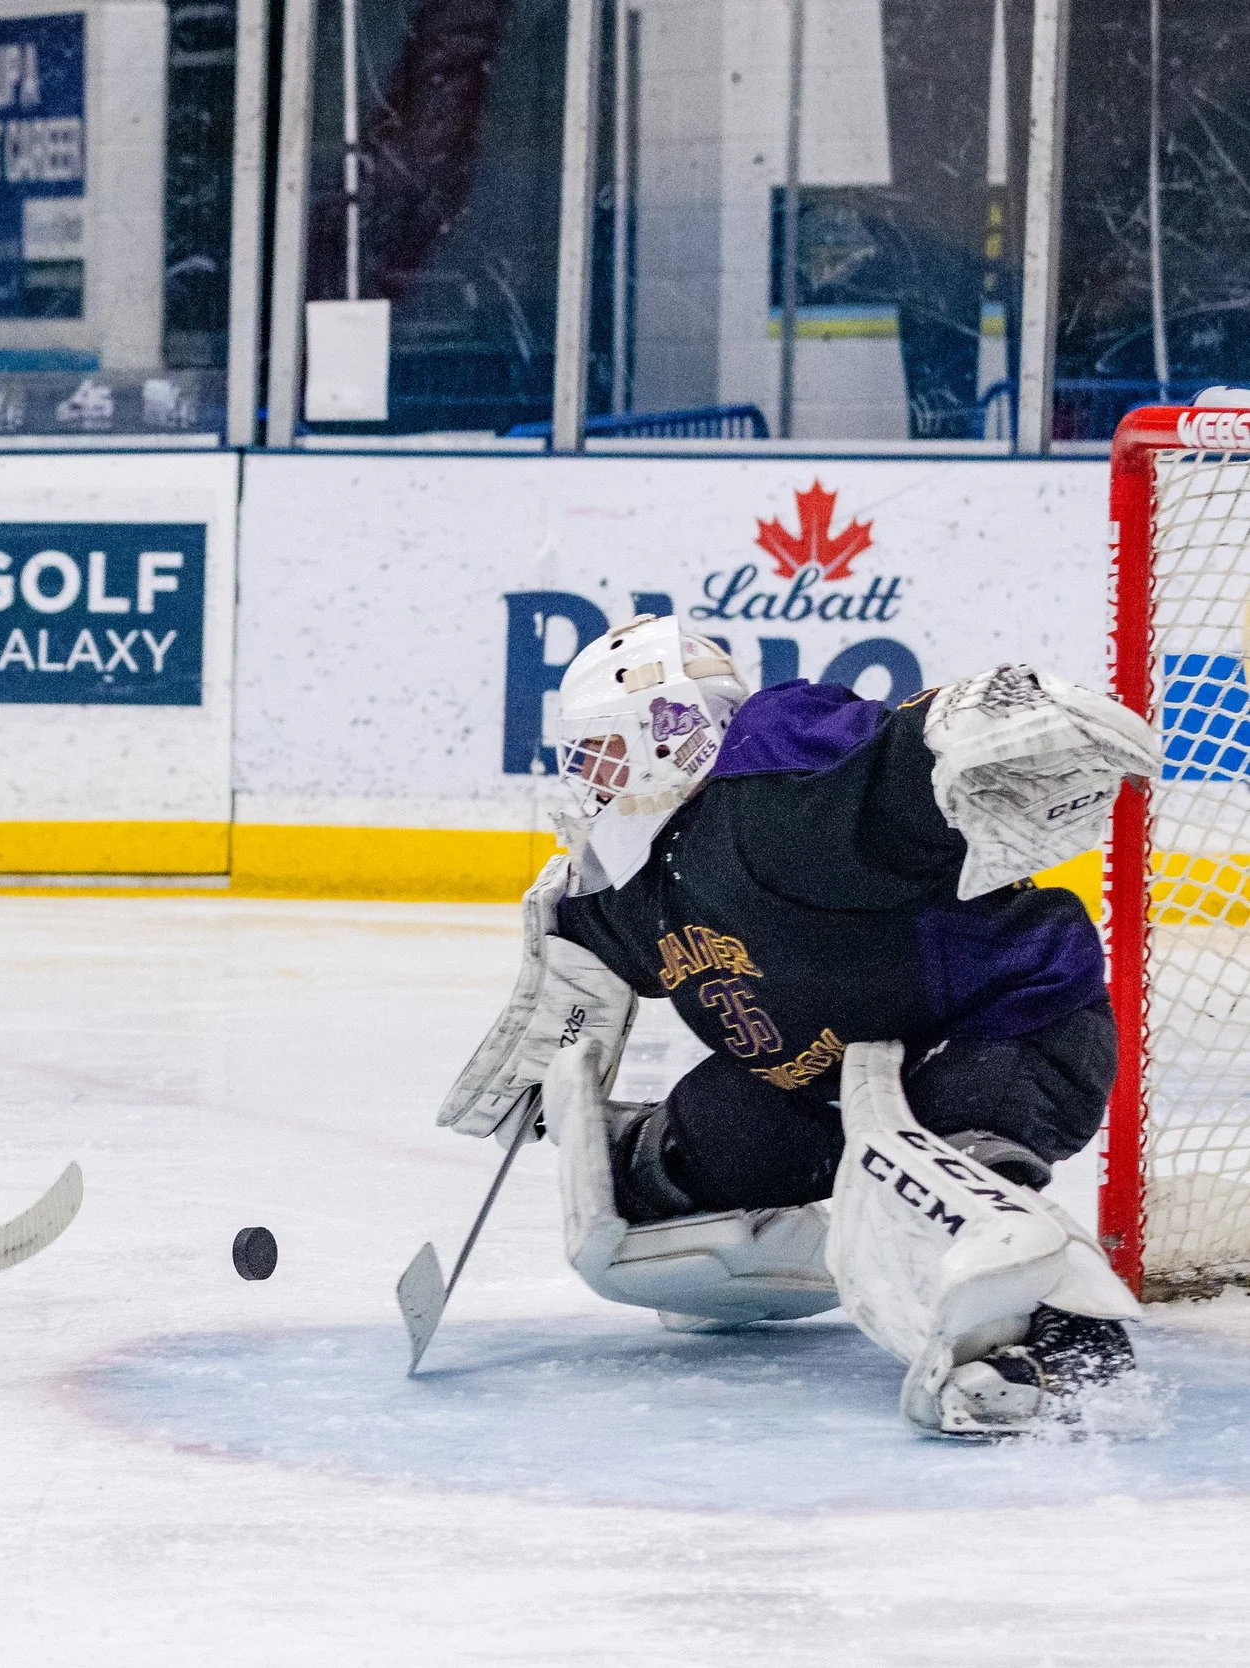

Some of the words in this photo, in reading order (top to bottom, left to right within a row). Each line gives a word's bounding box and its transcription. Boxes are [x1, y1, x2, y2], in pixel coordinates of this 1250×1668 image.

[689, 560, 903, 621] Labatt
[860, 1144, 966, 1237] CCM
[897, 1130, 1033, 1214] CCM
